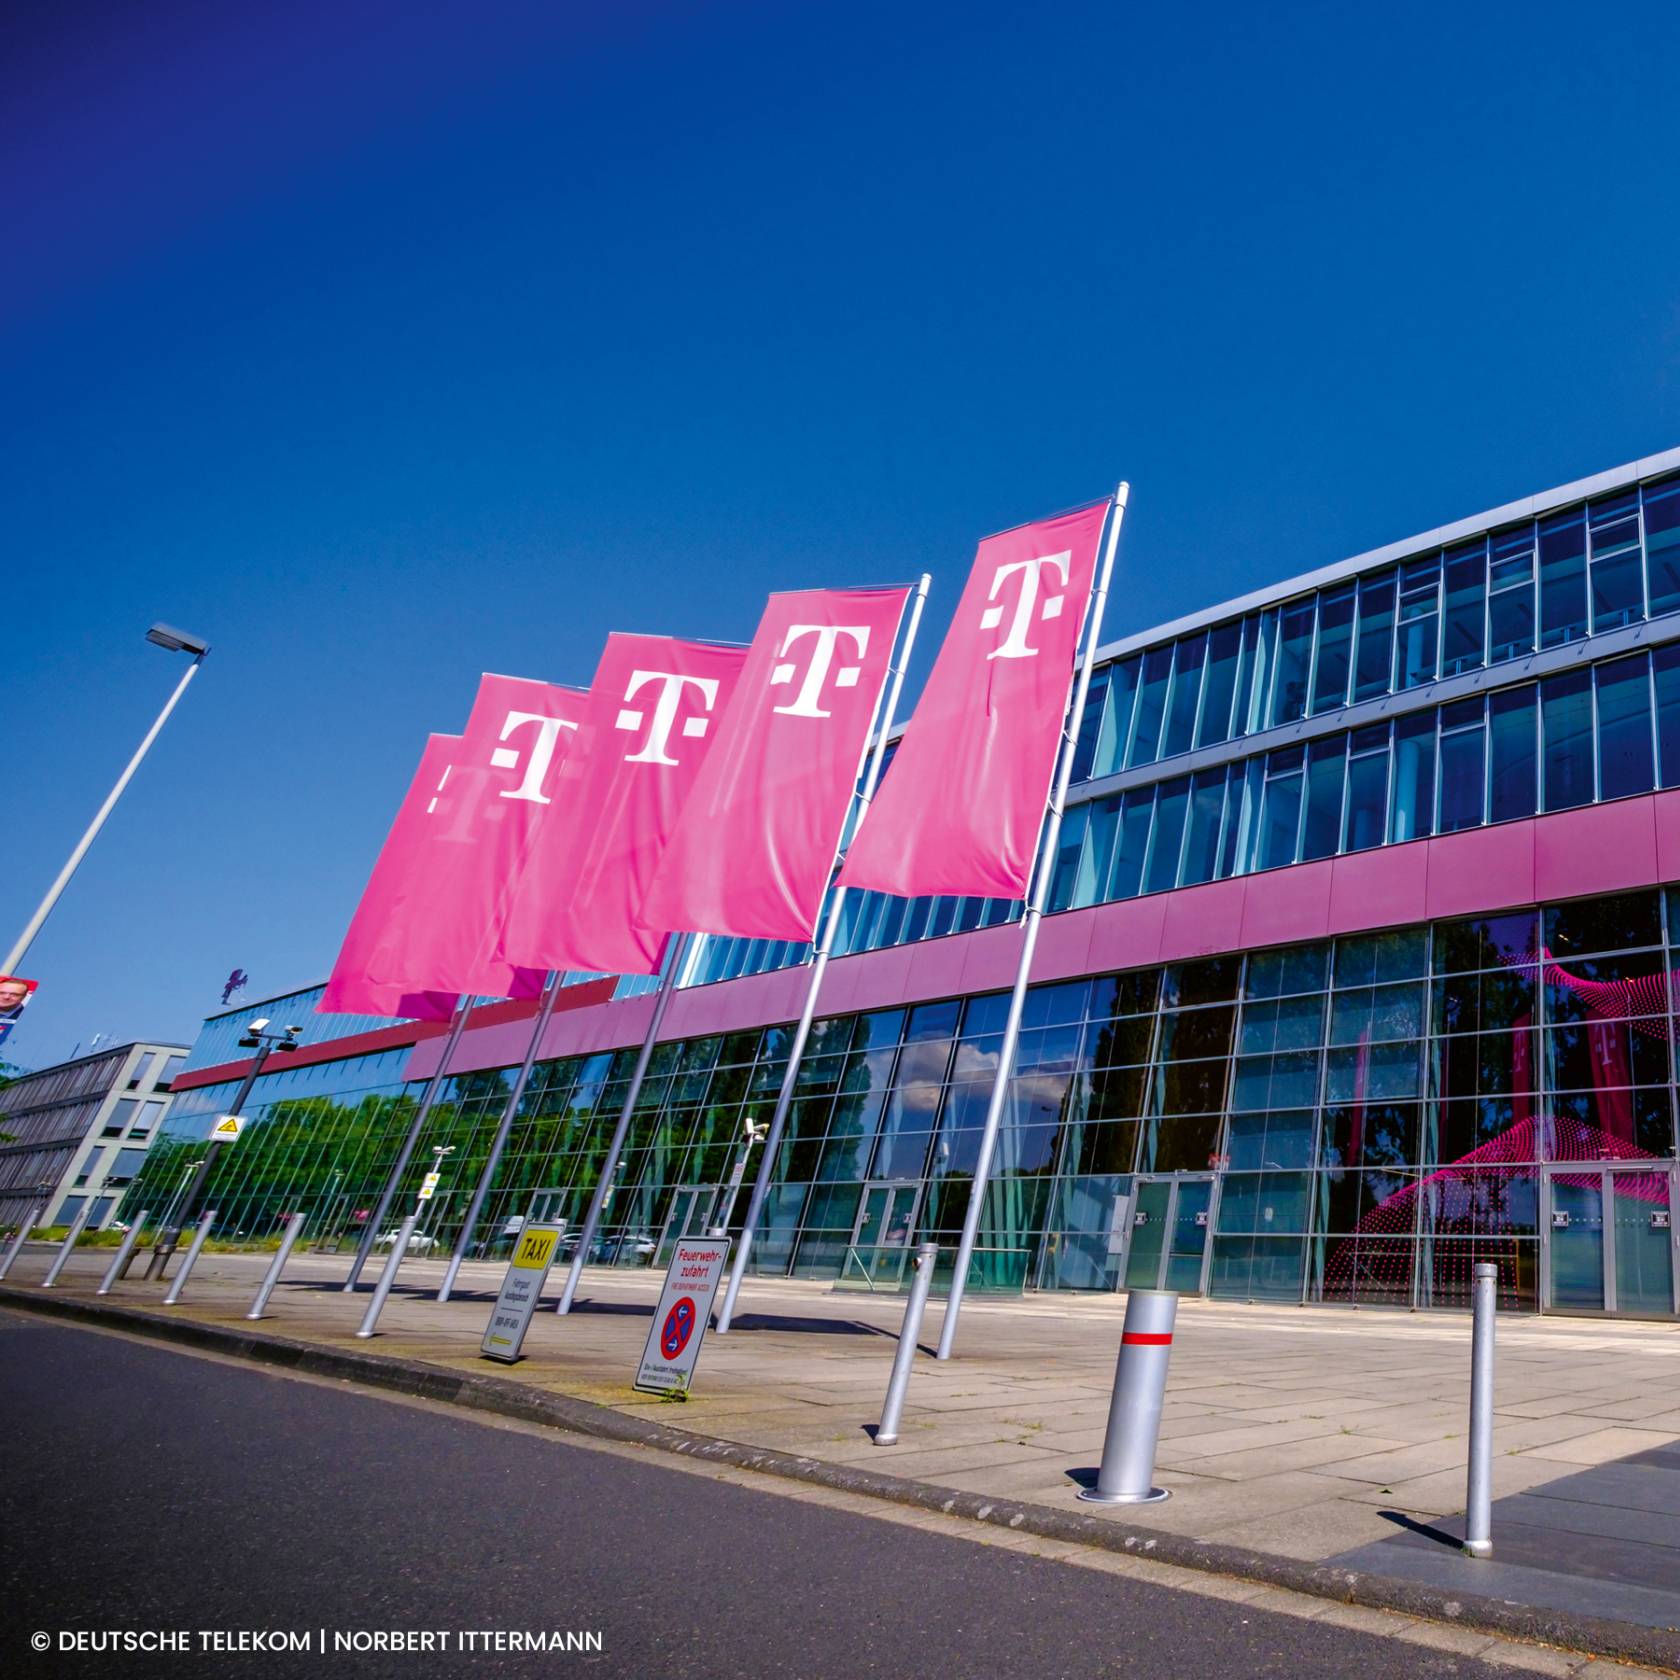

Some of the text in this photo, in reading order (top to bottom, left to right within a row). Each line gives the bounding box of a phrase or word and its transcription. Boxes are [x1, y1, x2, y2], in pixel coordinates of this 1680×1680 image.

[980, 550, 1071, 660] T
[770, 625, 871, 717] T
[615, 670, 719, 766] T
[521, 1238, 551, 1261] TAXI
[678, 1248, 721, 1262] Feuerwehr-
[680, 1264, 709, 1278] zufahrt
